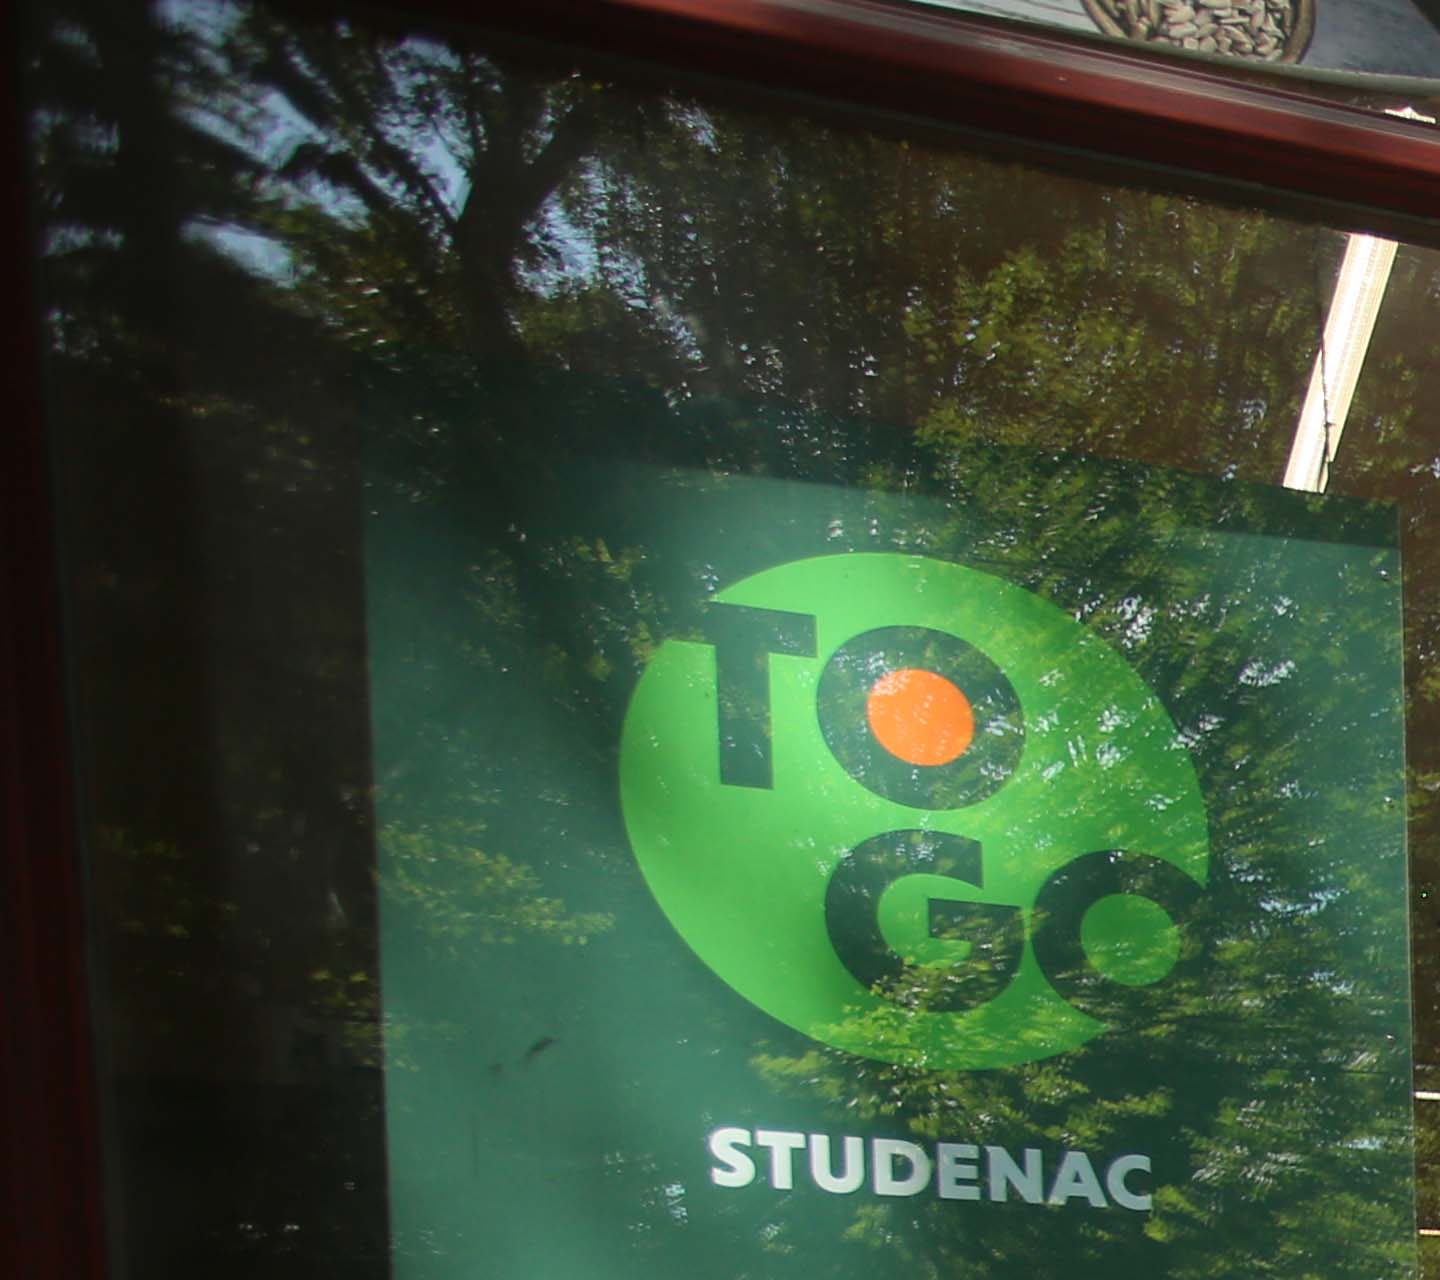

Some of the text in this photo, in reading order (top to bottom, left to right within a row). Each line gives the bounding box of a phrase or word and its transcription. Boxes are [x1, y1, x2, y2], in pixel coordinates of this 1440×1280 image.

[708, 602, 1024, 811] TO
[823, 828, 1210, 1014] GO
[709, 1127, 1154, 1211] STUDENAC
